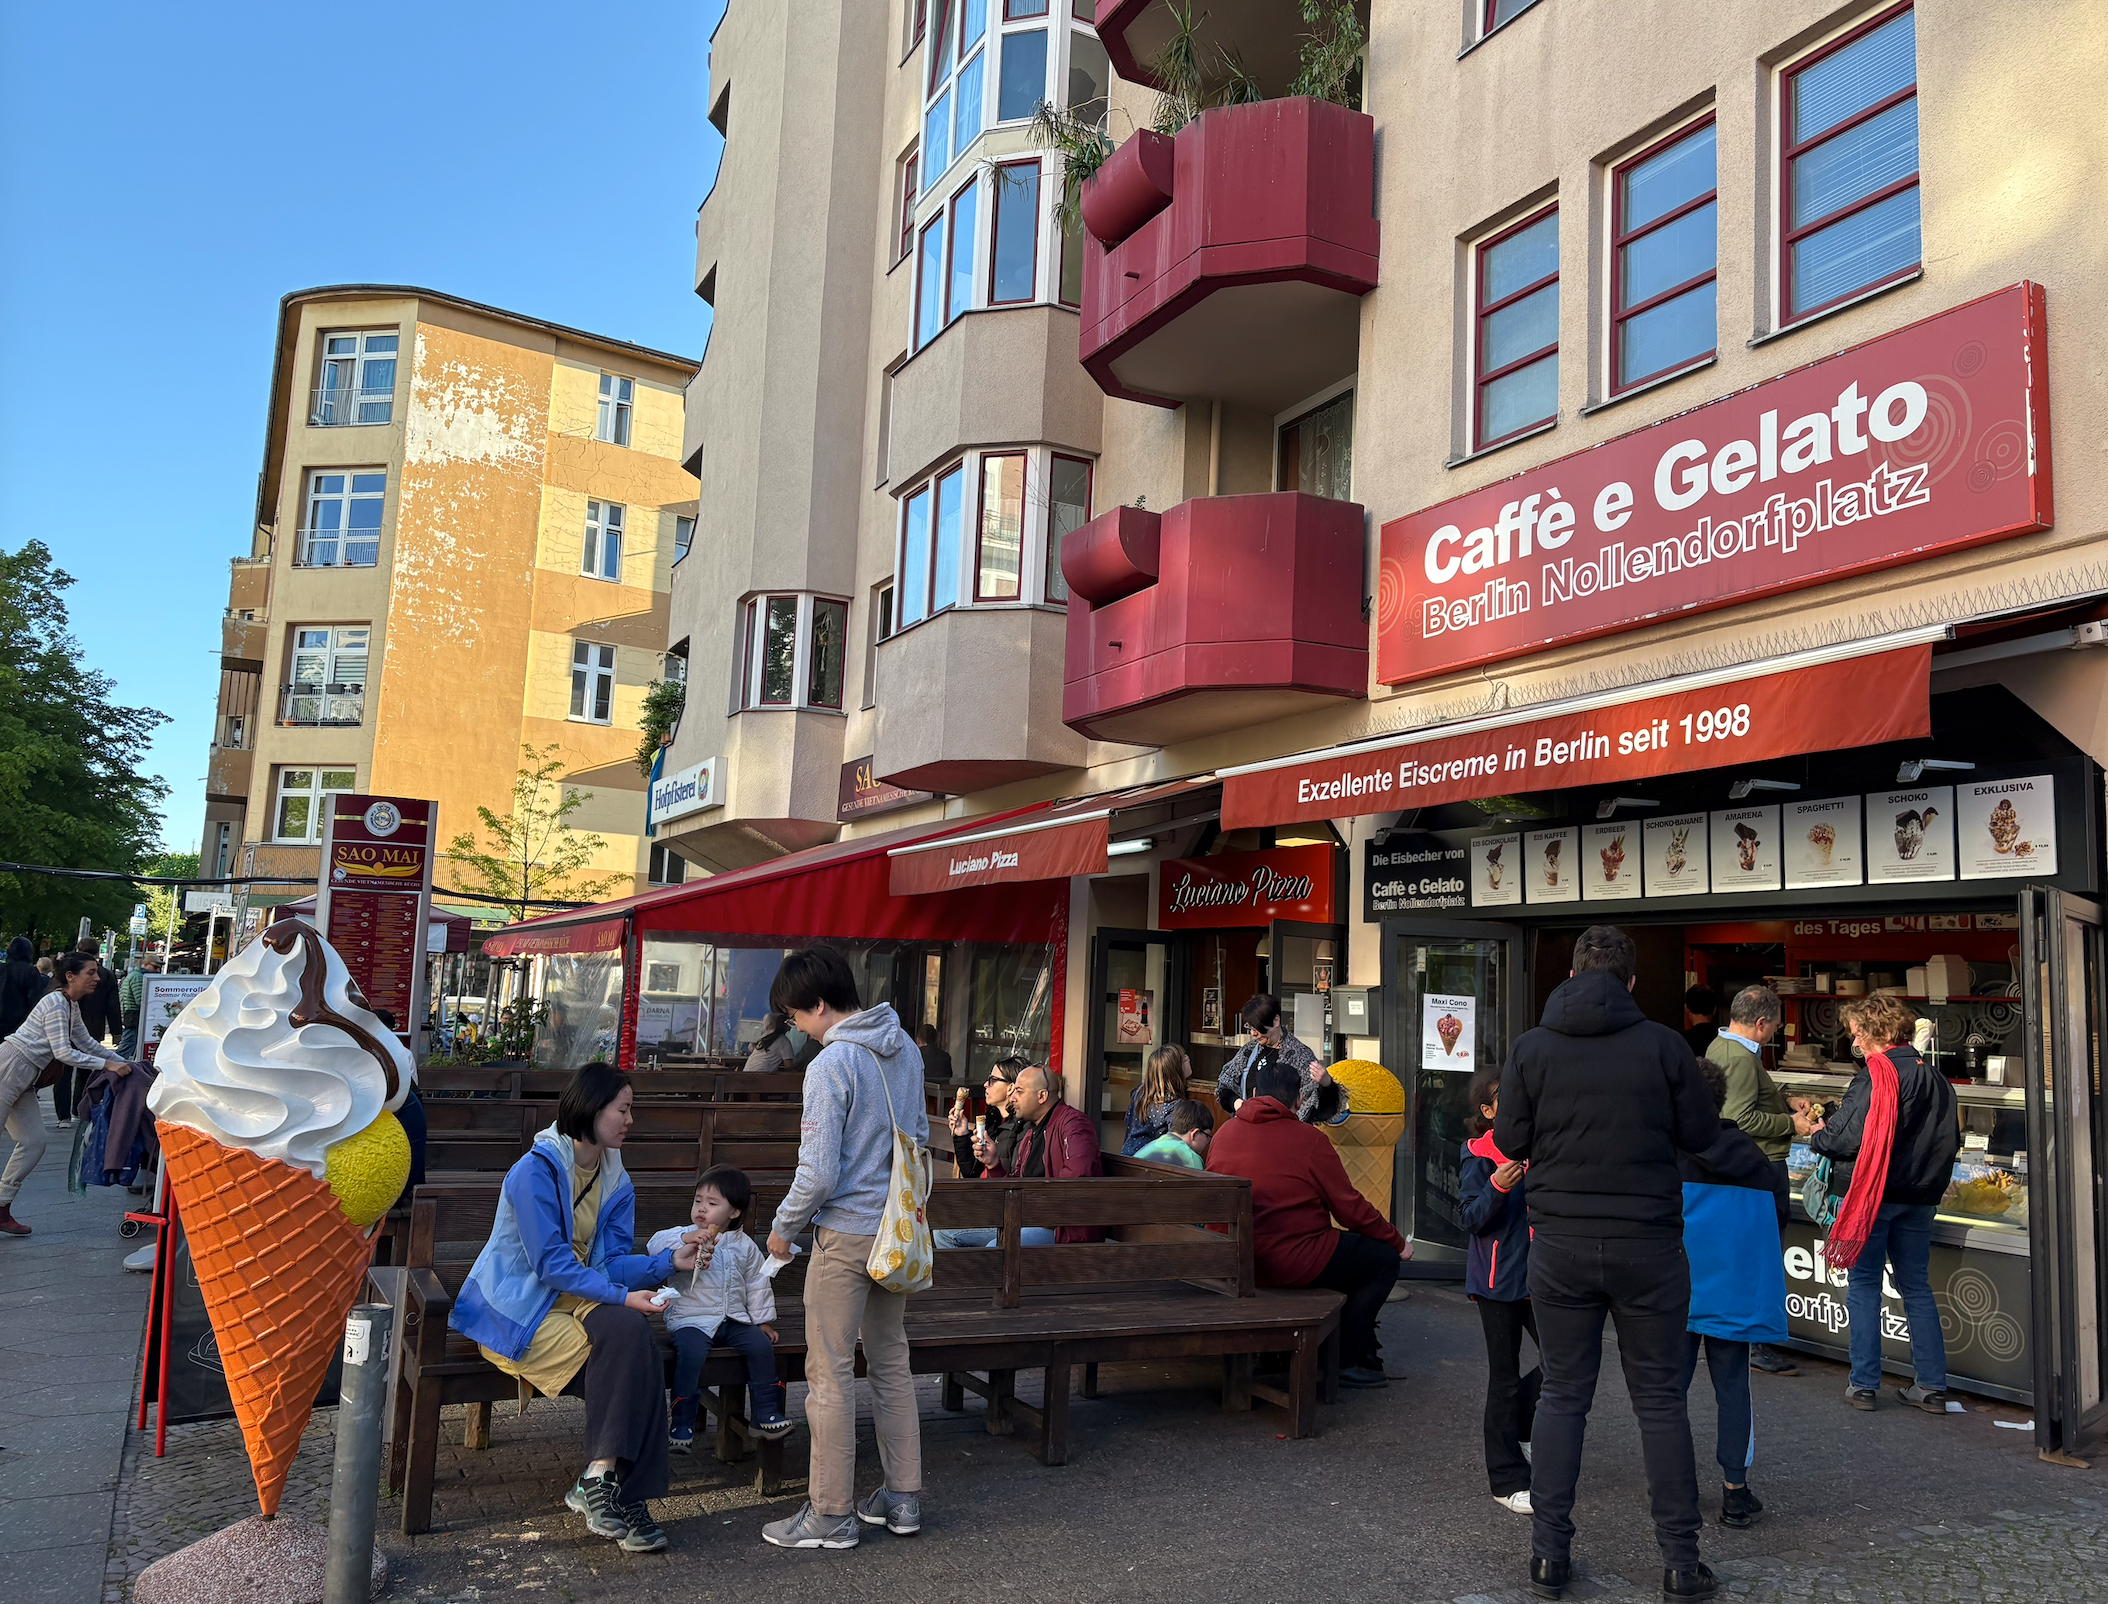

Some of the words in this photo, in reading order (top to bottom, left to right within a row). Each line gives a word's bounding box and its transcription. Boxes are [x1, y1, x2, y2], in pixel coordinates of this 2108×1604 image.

[1424, 487, 1576, 584] Caffè
[1593, 481, 1634, 532] e
[1654, 380, 1928, 511] Gelato
[1423, 576, 1531, 638] Berlin
[1542, 460, 1930, 606] Nollendorfplatz
[1297, 768, 1393, 803] Exzellente
[1399, 753, 1498, 789] Eiscreme
[1504, 744, 1526, 772] in
[1534, 731, 1610, 767] Berlin
[1617, 719, 1670, 755] seit
[1679, 703, 1751, 745] 1998
[655, 773, 696, 814] Hofpfisterei
[1974, 782, 2034, 796] EXKLUSIVA
[842, 799, 864, 812] GESUNDE
[1888, 793, 1929, 804] SCHOKO
[1725, 811, 1763, 821] AMARENA
[1797, 802, 1844, 814] SPAGHETTI
[1595, 825, 1626, 834] ERDBEER
[1646, 816, 1704, 830] SCHOKO-BANANE
[1481, 836, 1518, 847] SCHOKOLADE
[1544, 831, 1568, 840] KAFFEE
[337, 846, 376, 861] SAO
[382, 848, 419, 864] MAI
[949, 855, 989, 876] Luciano
[989, 850, 1019, 869] Pizza
[1372, 854, 1389, 866] Die
[1391, 850, 1443, 864] Eisbecher
[1445, 848, 1465, 860] von
[1169, 872, 1249, 913] Luciano
[1251, 864, 1315, 907] Pizza
[1372, 881, 1406, 897] Caffè
[1408, 883, 1418, 895] e
[1420, 877, 1465, 894] Gelato
[1372, 899, 1398, 911] Berlin
[1398, 895, 1466, 910] Nollendorfplatz
[1793, 920, 1824, 936] des
[1827, 919, 1881, 938] Tages
[1431, 998, 1447, 1006] Maxi
[1449, 999, 1468, 1007] Cono
